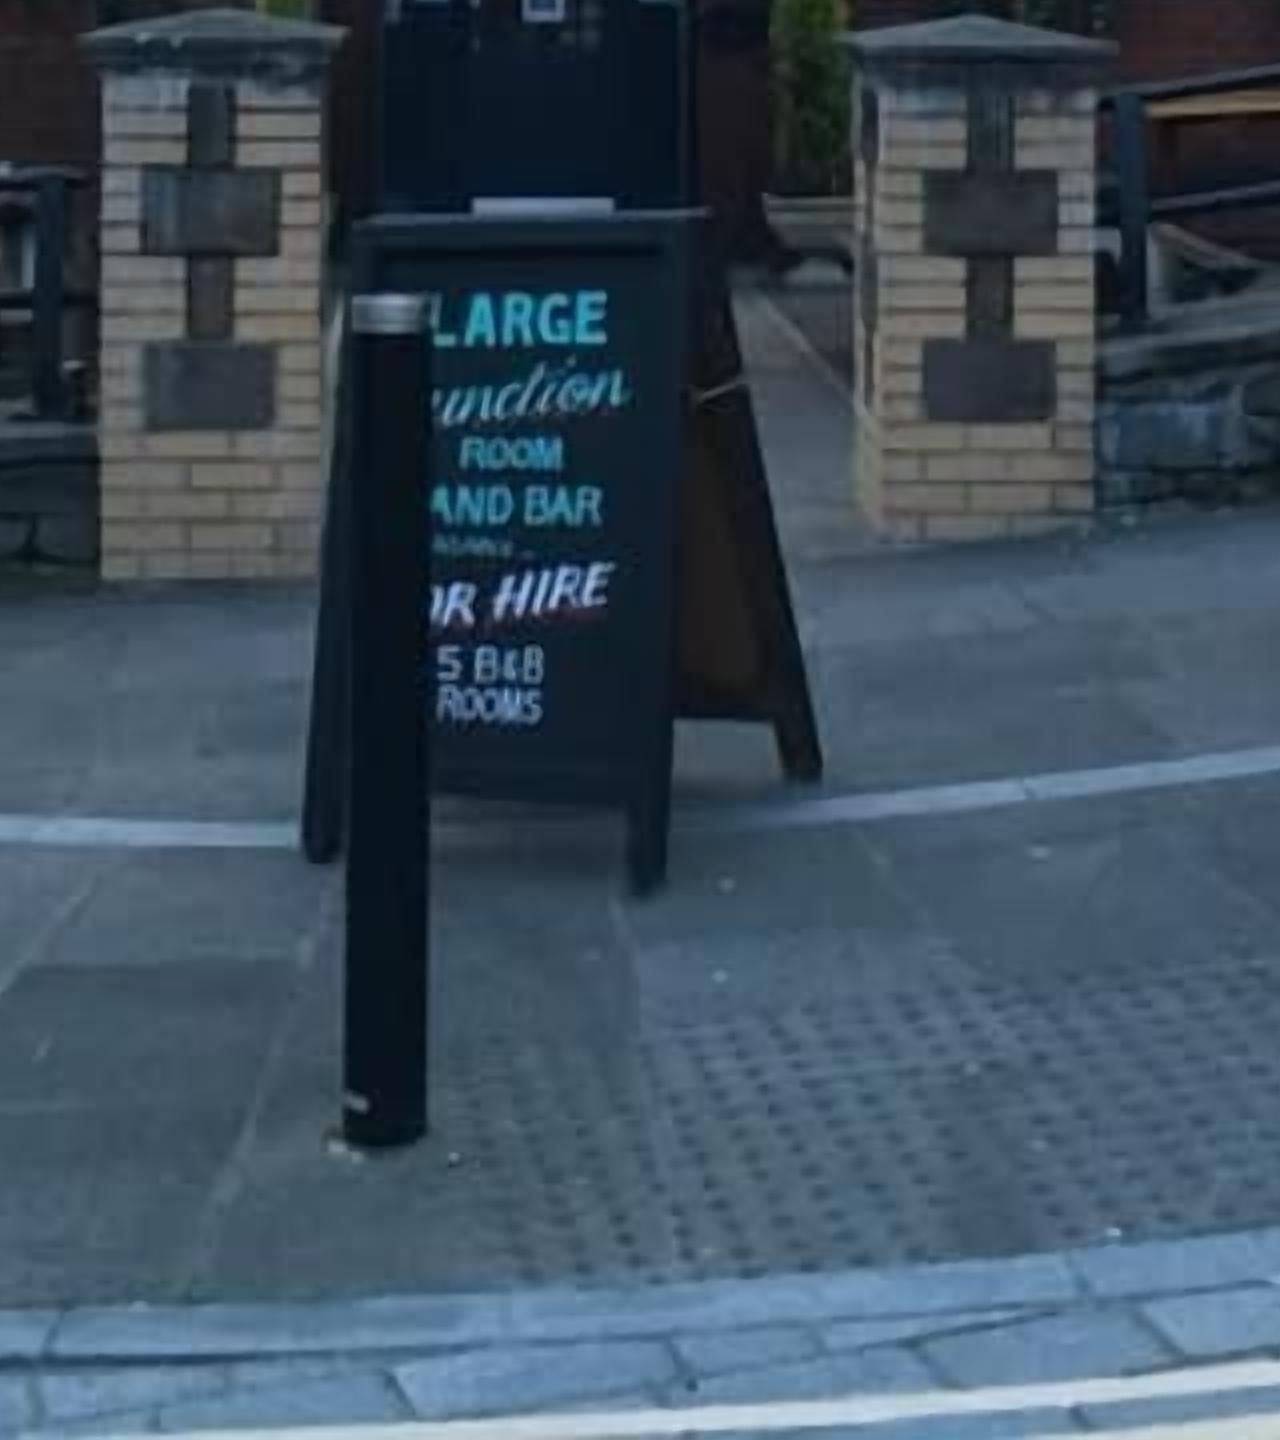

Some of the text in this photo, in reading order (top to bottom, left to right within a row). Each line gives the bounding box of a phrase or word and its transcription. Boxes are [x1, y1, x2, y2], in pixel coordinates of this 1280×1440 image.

[429, 290, 607, 348] LARGE
[458, 435, 564, 470] ROOM
[431, 484, 604, 527] AND BAR
[492, 561, 616, 622] HIRE
[437, 644, 463, 681] 5
[437, 683, 544, 725] ROOMS
